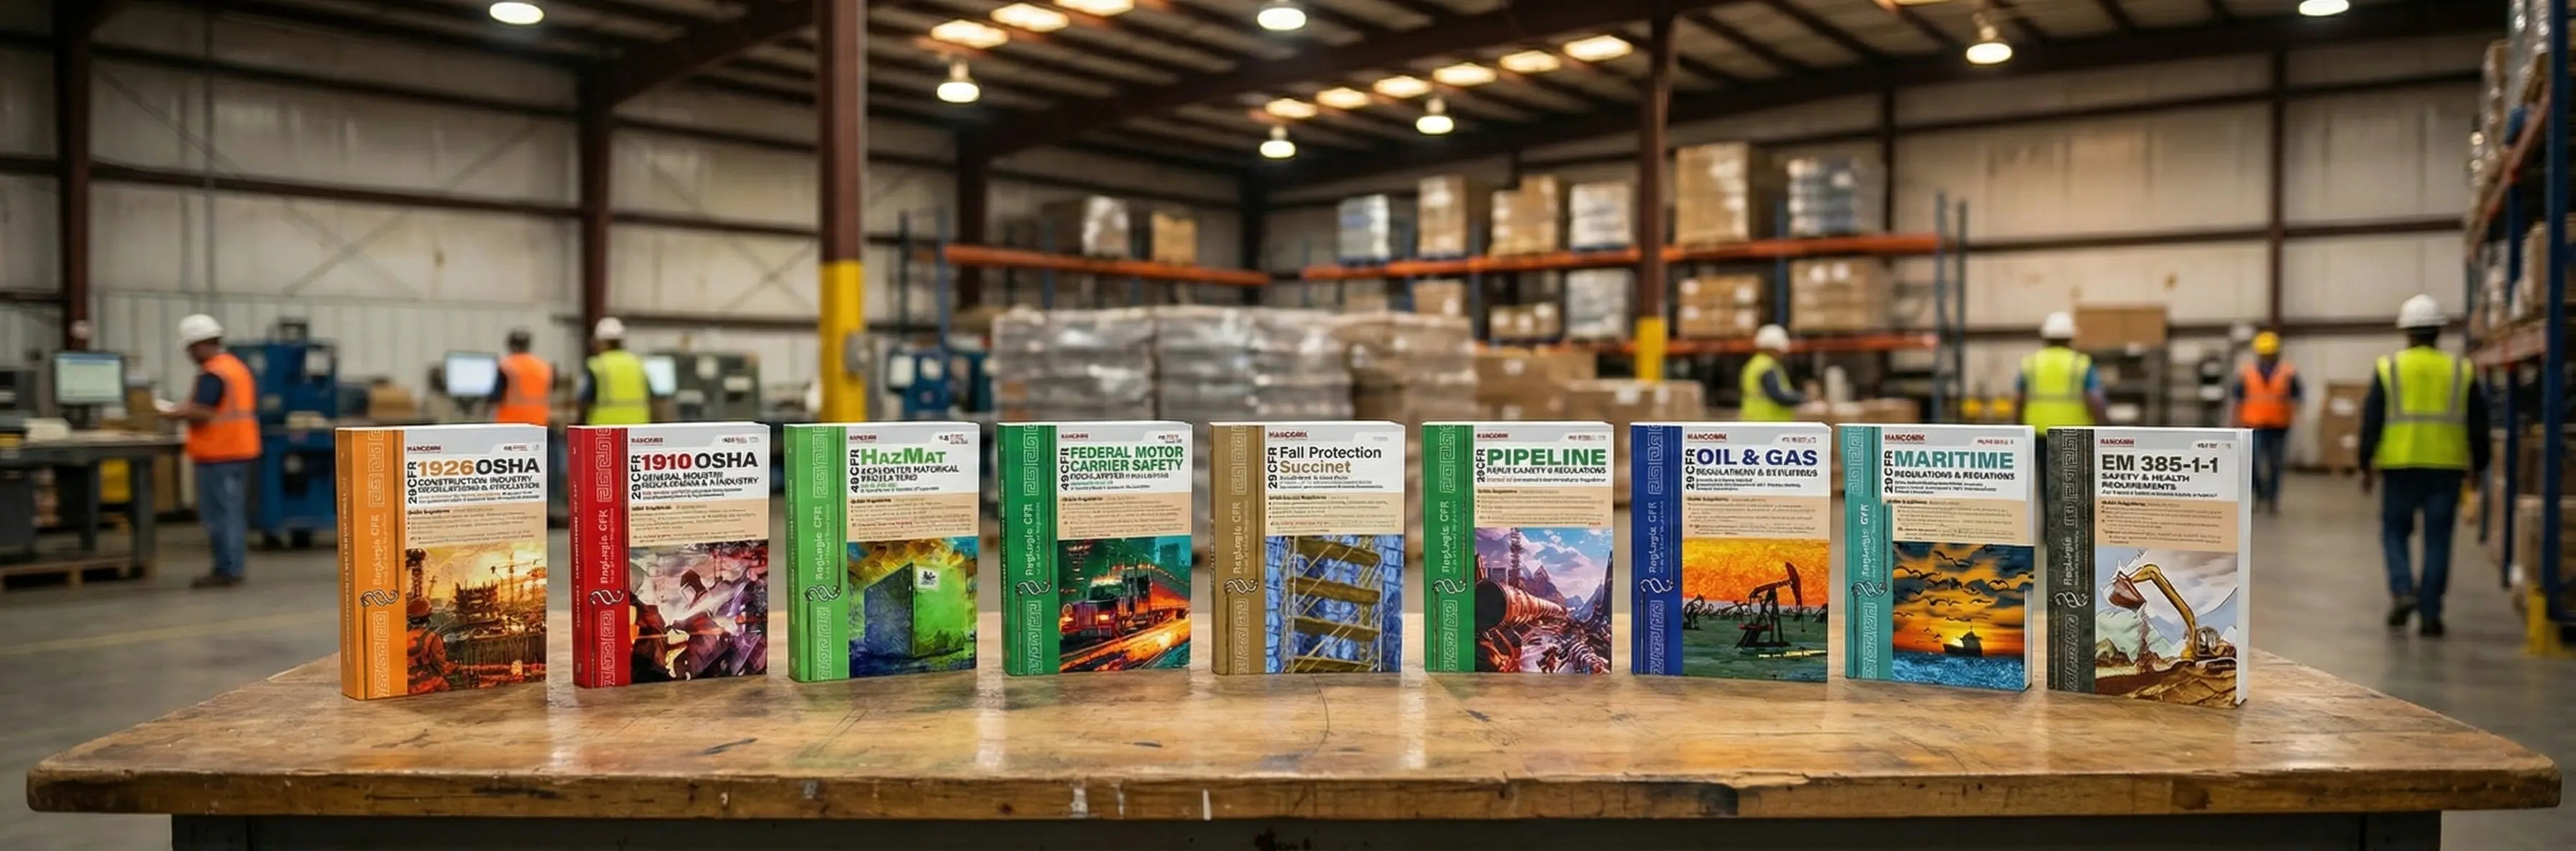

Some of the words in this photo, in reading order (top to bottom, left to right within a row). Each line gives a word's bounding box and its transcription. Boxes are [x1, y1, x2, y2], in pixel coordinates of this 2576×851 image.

[641, 454, 692, 470] 1910
[694, 452, 758, 468] OSHA
[1070, 446, 1131, 459] FEDERAL
[1136, 446, 1184, 458] MOTOR
[1280, 446, 1304, 459] Fall
[1309, 446, 1381, 459] Protection
[1487, 448, 1606, 466] PIPELINE
[1697, 448, 1737, 465] OIL
[1742, 448, 1760, 466] &
[1765, 449, 1818, 466] GAS
[1895, 451, 2014, 469] MARITIME
[418, 460, 474, 477] 1926
[476, 458, 540, 474] OSHA
[1070, 461, 1129, 472] CARRIER
[1132, 459, 1184, 471] SAFETY
[1279, 460, 1351, 473] Succinet
[2102, 454, 2135, 471] EM
[2141, 456, 2218, 473] 385-1-1
